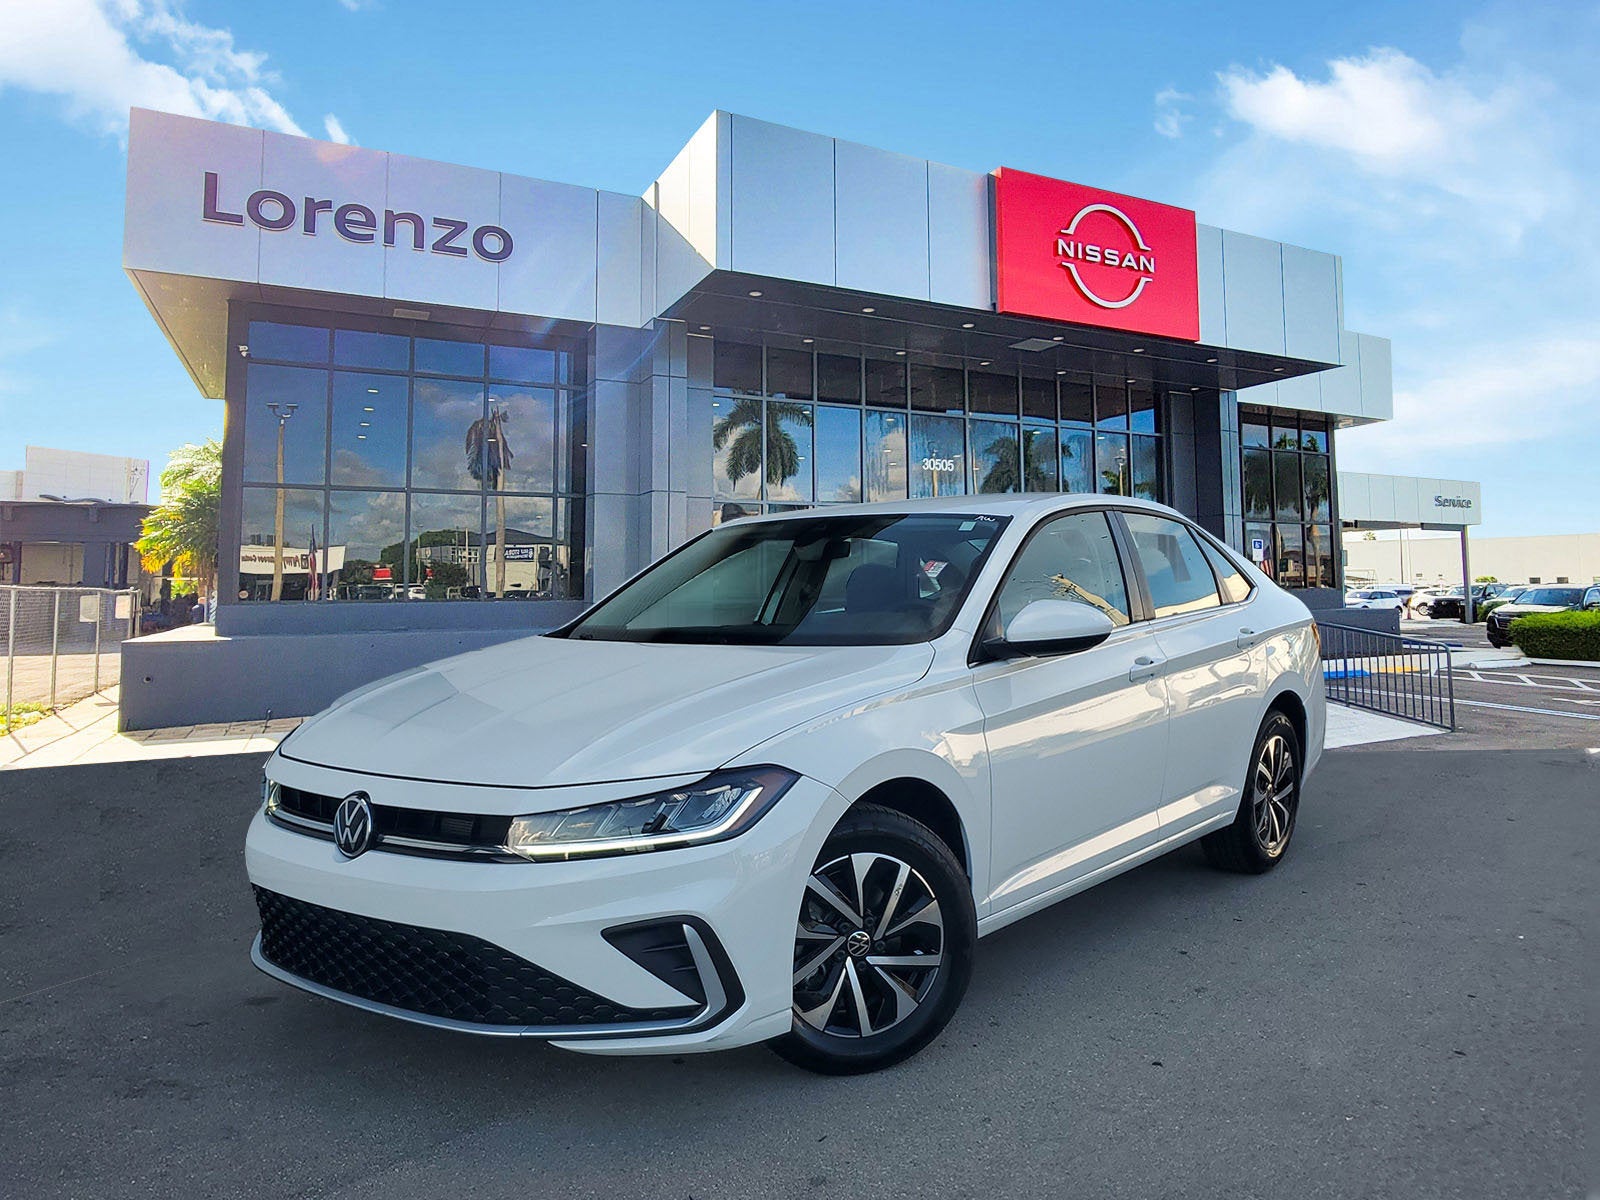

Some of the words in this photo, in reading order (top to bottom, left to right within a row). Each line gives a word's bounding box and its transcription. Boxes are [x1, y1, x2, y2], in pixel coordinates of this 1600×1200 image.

[202, 171, 514, 262] Lorenzo
[1057, 238, 1155, 273] NISSAN
[922, 458, 954, 471] 30505
[1434, 495, 1472, 508] Service
